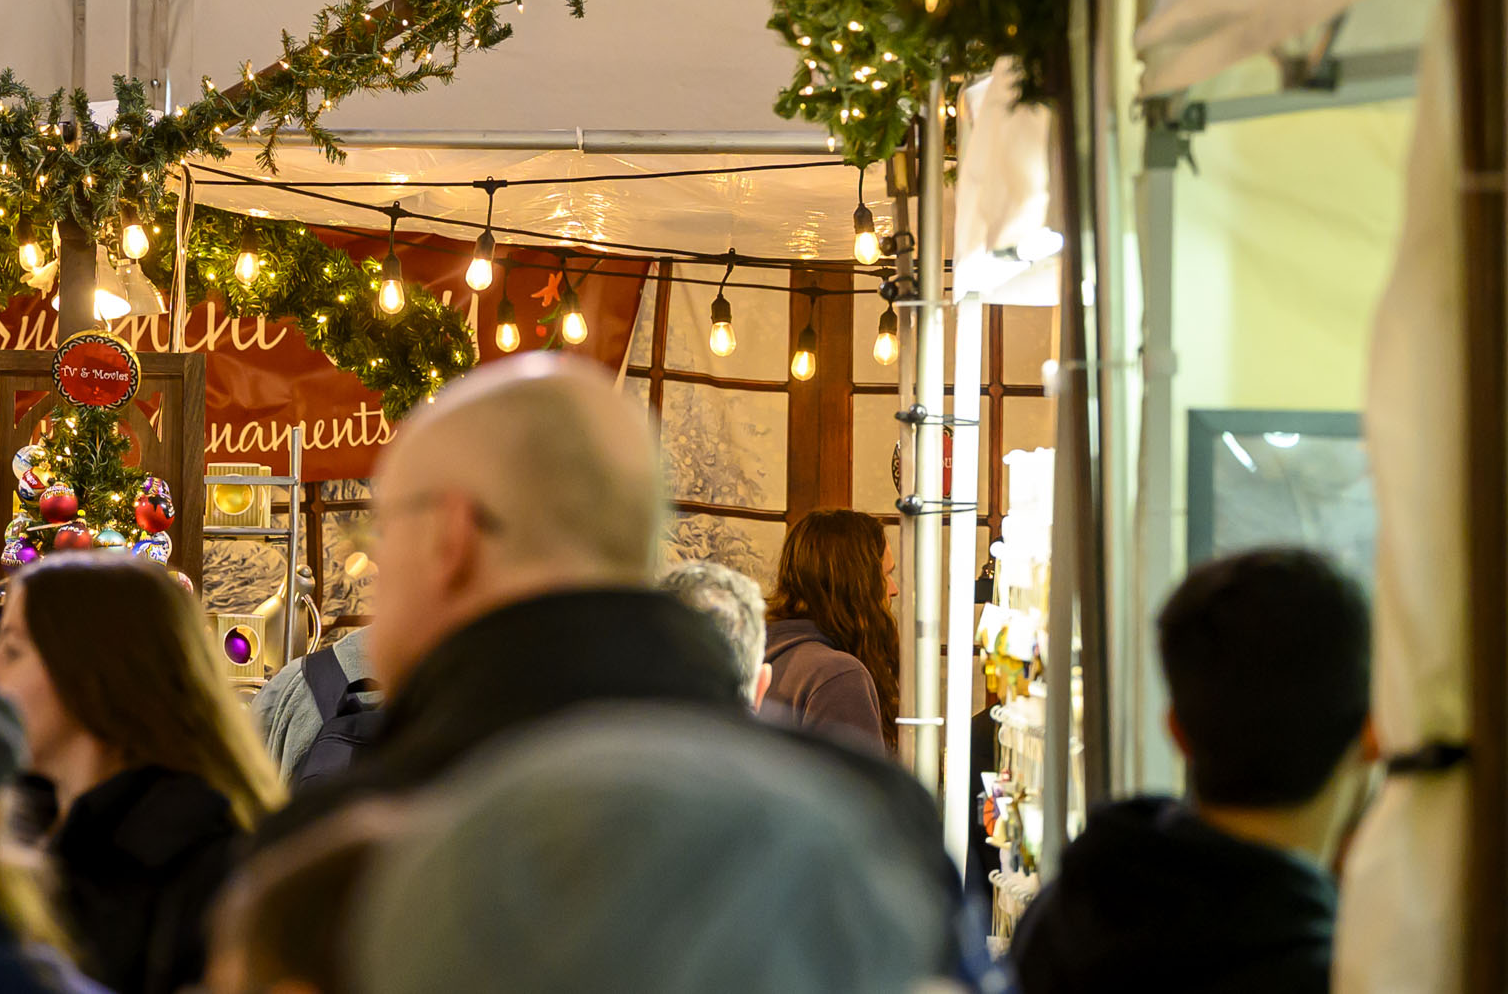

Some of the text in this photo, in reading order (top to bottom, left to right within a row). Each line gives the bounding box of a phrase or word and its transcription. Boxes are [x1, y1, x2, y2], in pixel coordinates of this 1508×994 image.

[60, 366, 129, 381] TV & Movies
